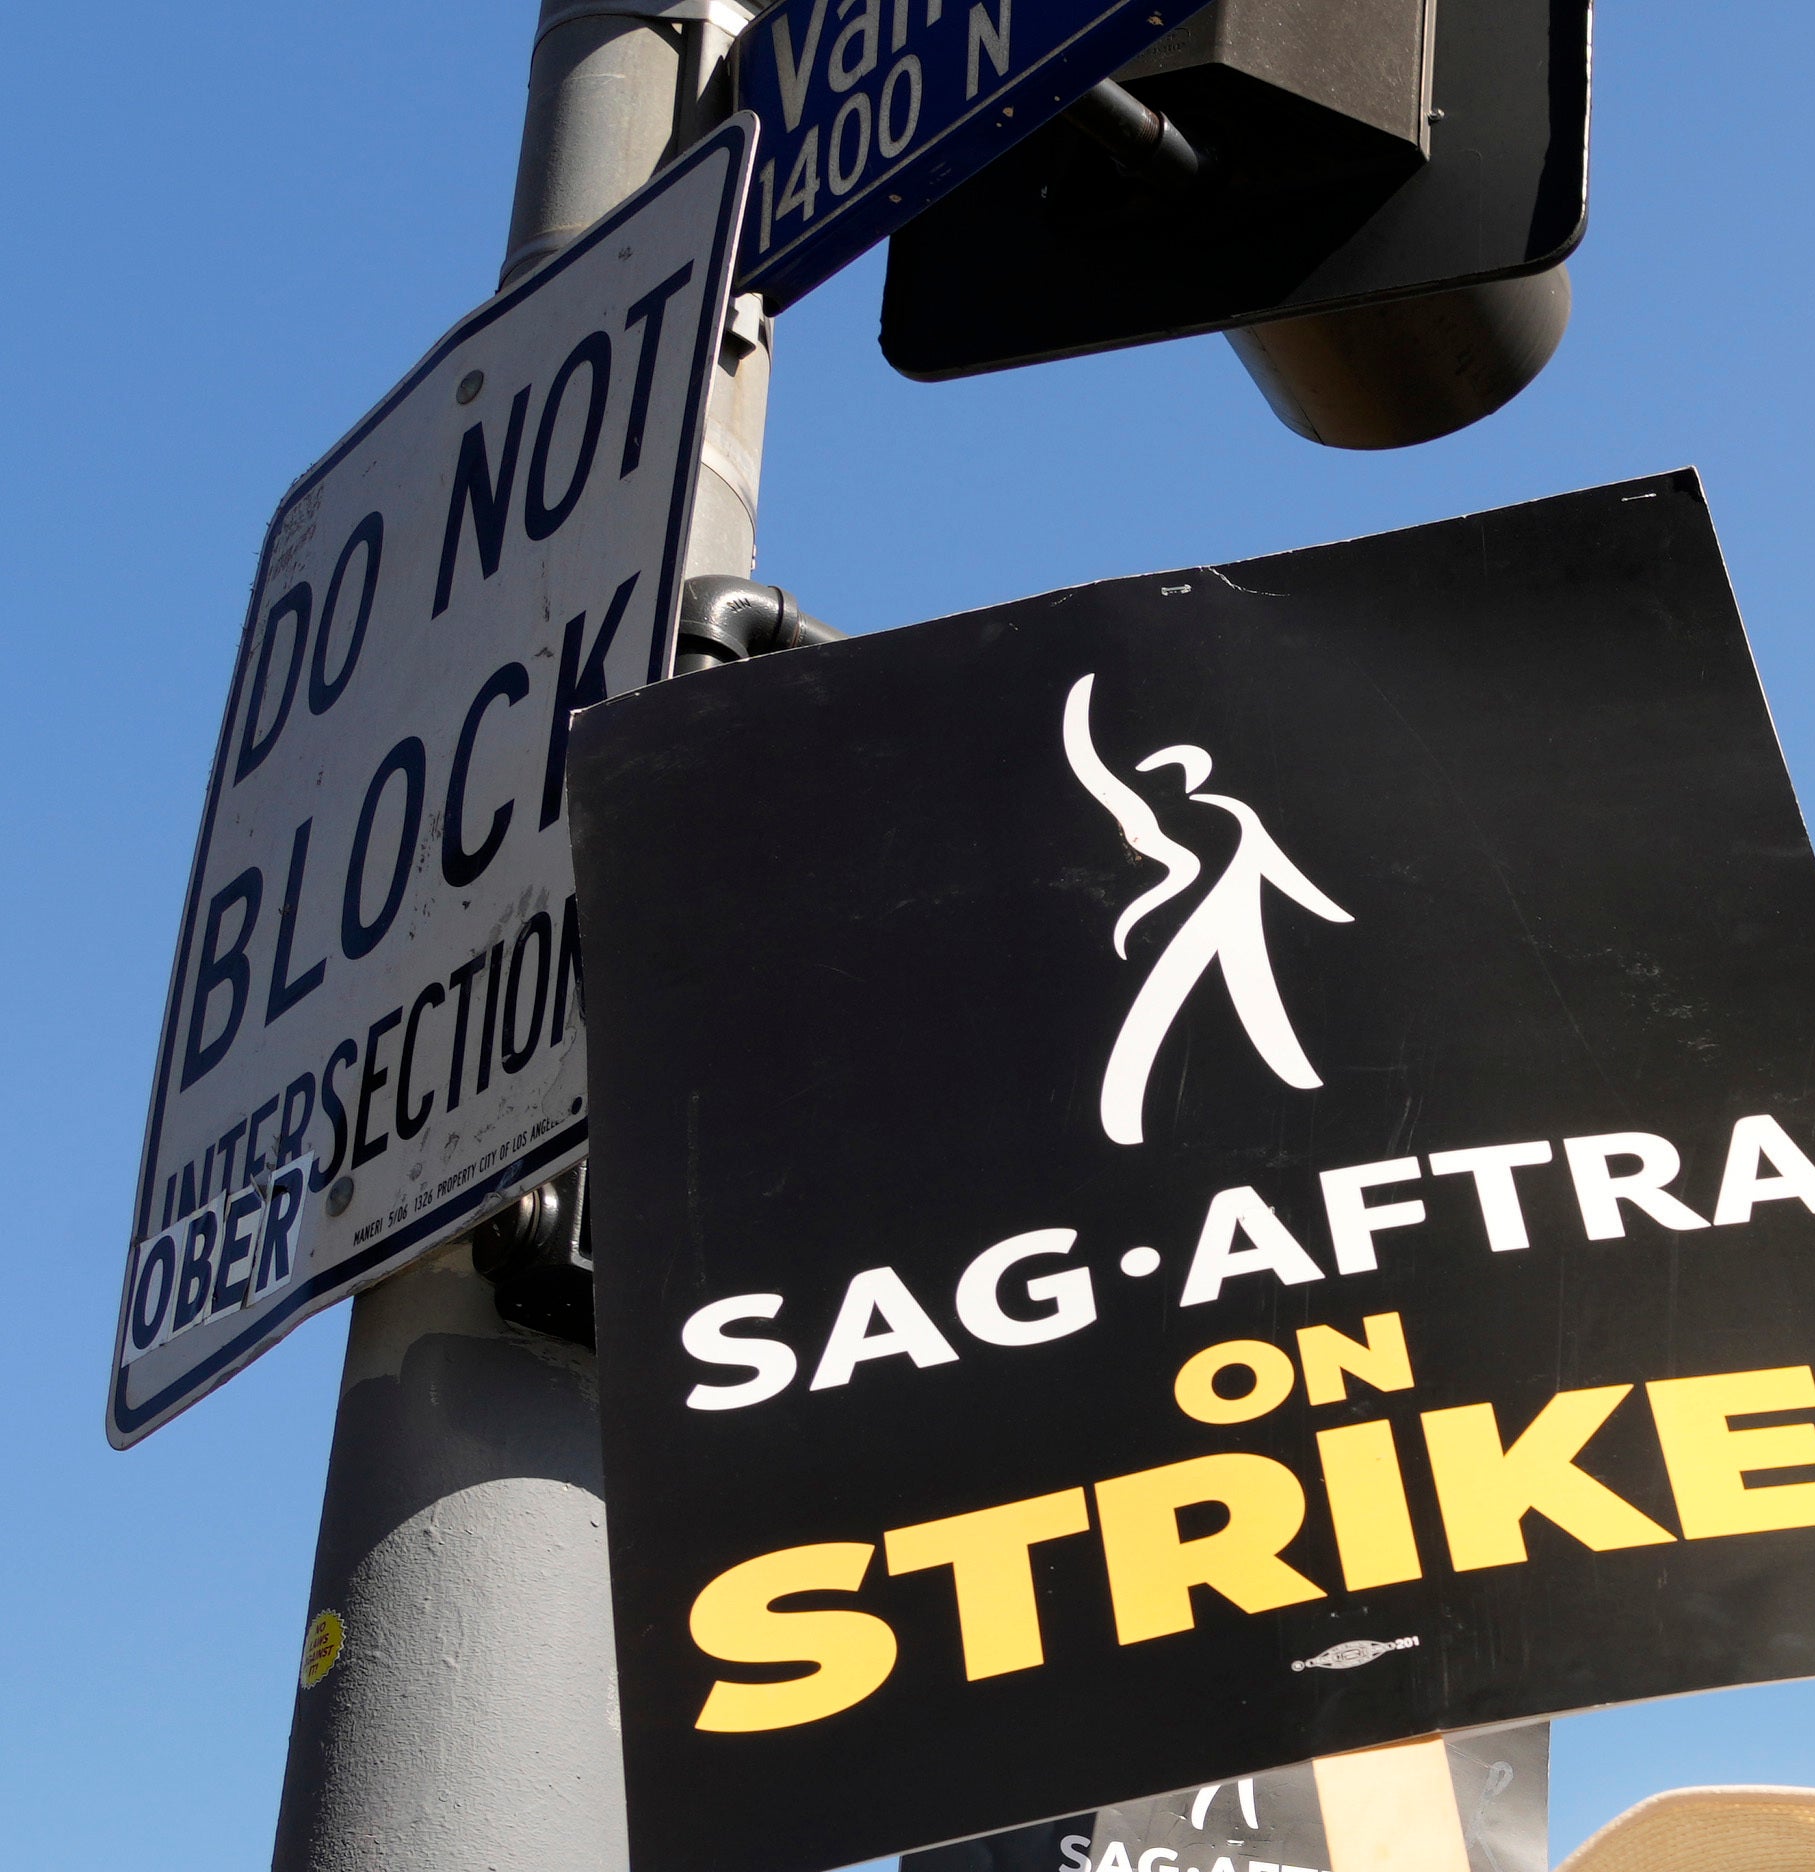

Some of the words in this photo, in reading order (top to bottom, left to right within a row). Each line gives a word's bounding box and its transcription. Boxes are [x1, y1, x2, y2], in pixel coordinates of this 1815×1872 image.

[758, 54, 922, 254] 1400
[233, 511, 383, 788] DO
[432, 261, 694, 619] NOT
[180, 570, 642, 1094] BLOCK
[132, 1166, 305, 1350] OBER
[353, 1218, 383, 1247] MANERI
[437, 1161, 477, 1199] PROPERTY
[479, 1149, 498, 1173] CITY
[499, 1142, 511, 1161] OF
[512, 1130, 528, 1153] LOS
[1174, 1311, 1415, 1425] ON
